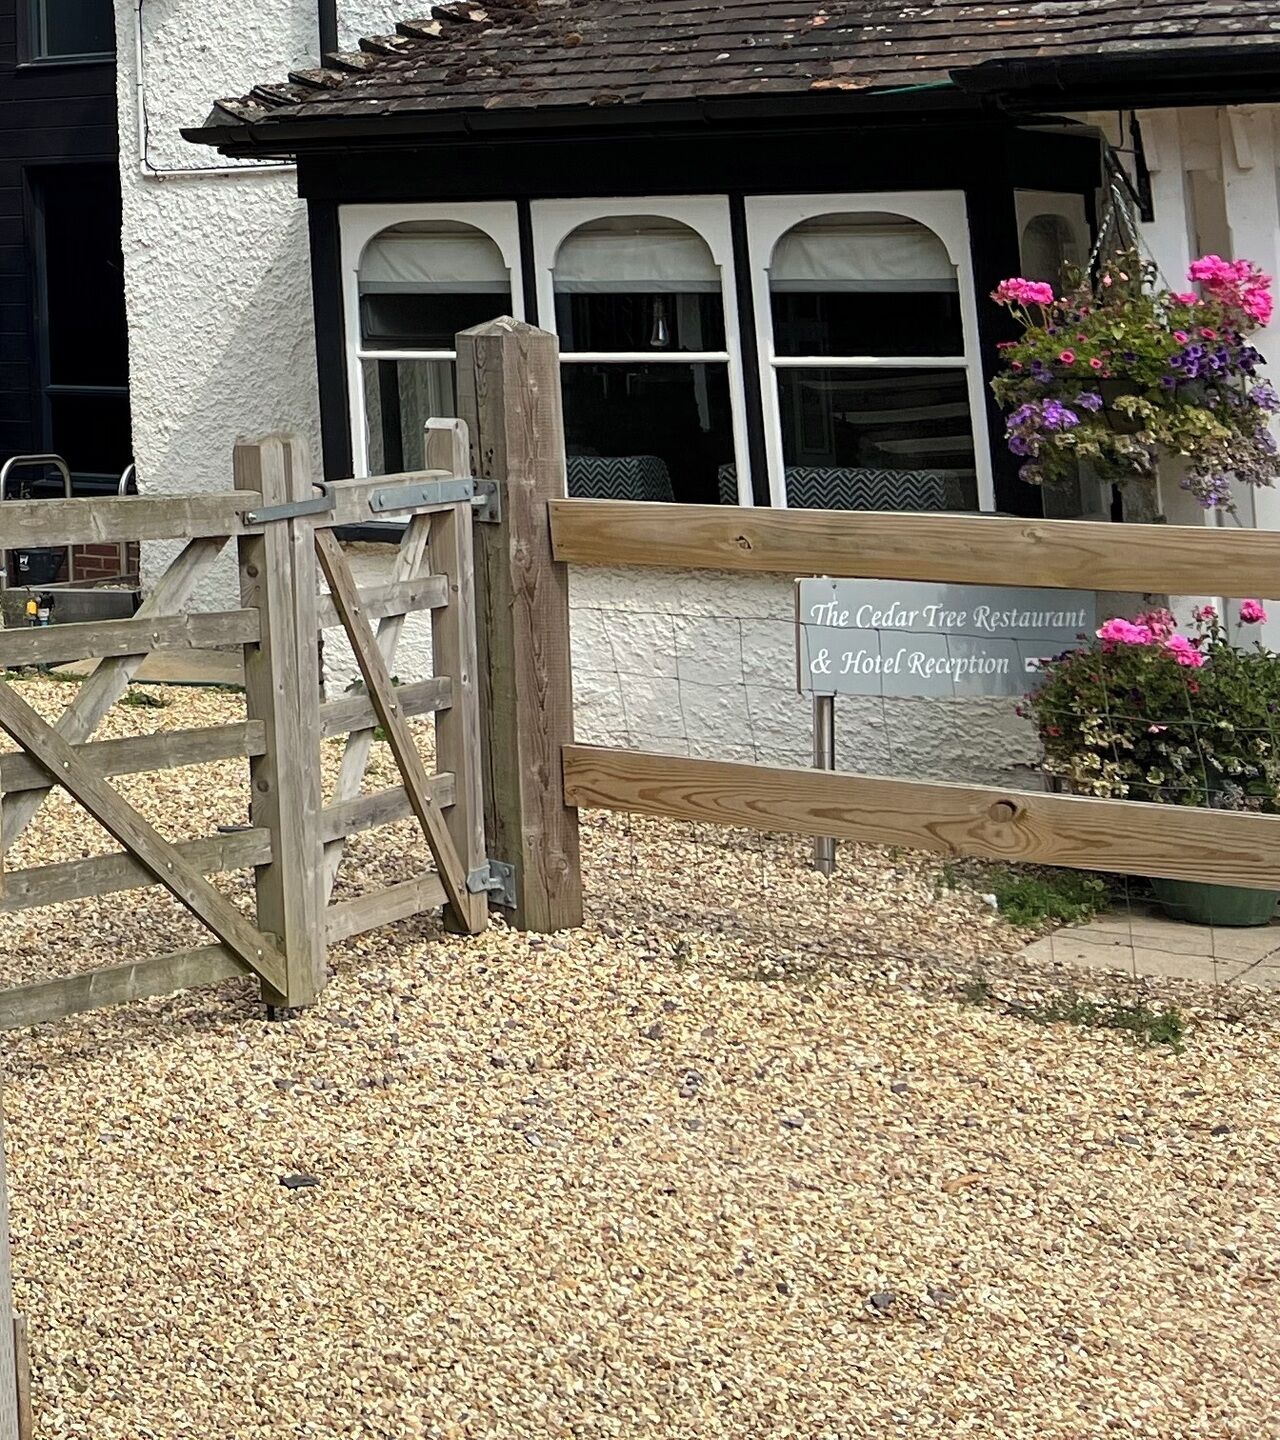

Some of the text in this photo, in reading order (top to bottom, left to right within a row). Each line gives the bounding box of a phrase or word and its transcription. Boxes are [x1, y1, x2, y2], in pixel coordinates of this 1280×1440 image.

[811, 602, 1087, 631] The Cedar Tree Restaurant
[810, 649, 1009, 682] & Hotel Reception
